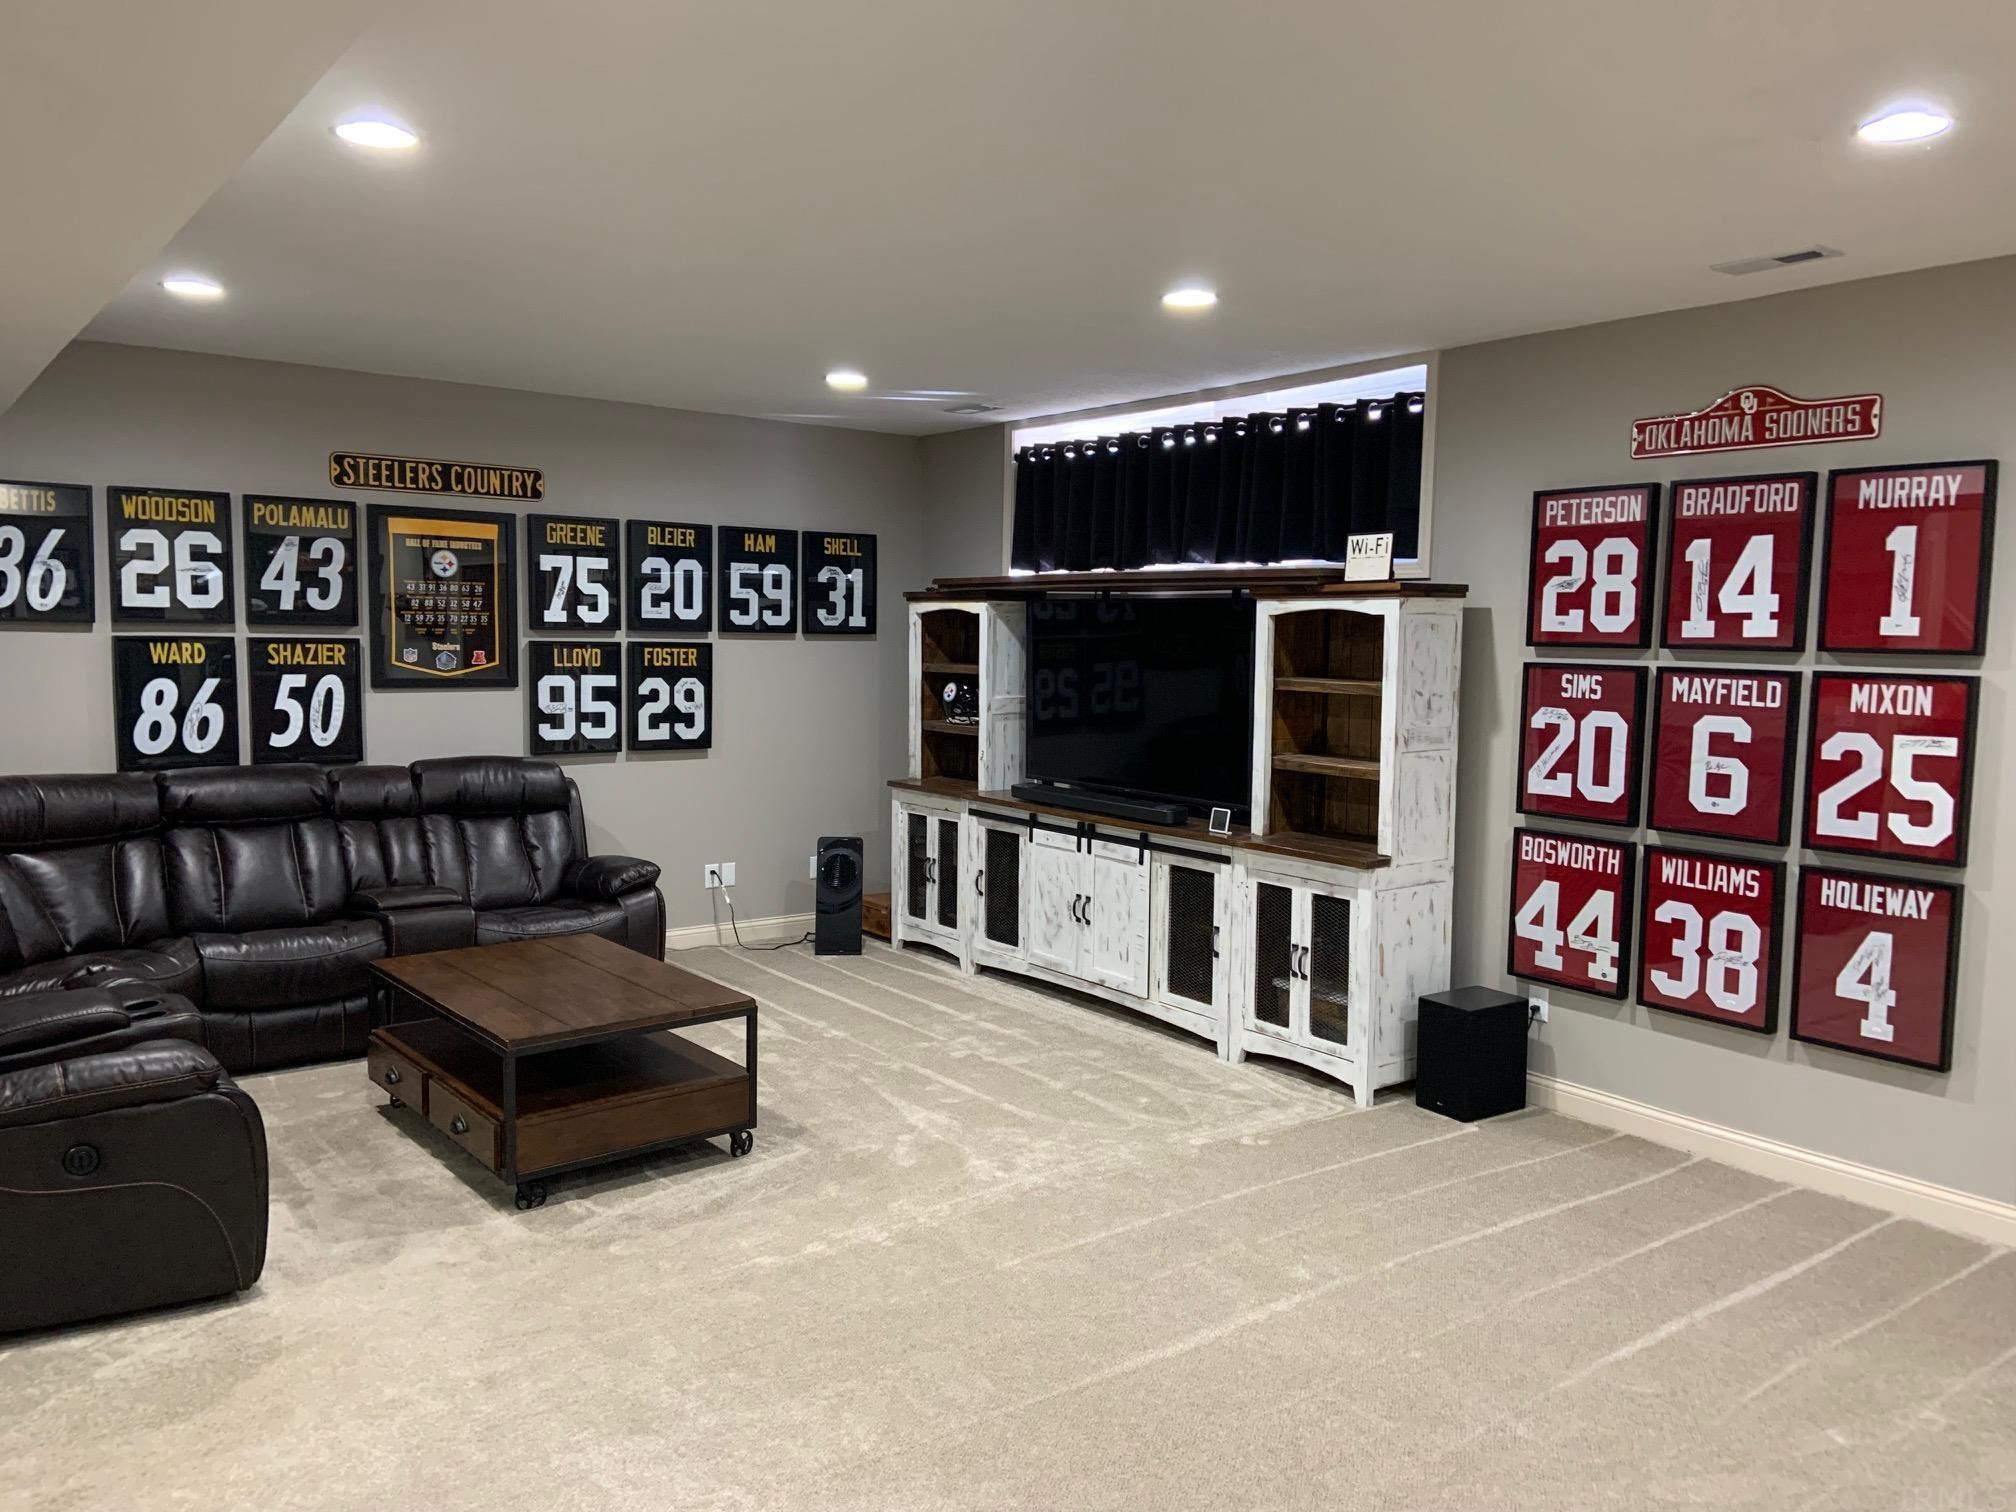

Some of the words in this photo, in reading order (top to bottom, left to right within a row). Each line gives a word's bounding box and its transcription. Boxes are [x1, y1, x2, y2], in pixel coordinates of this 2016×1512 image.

[1644, 414, 1754, 451] OKLAHOMA
[1765, 404, 1860, 439] SOONERS
[343, 458, 442, 489] STEELERS
[450, 465, 535, 498] COUNTRY
[1859, 474, 1963, 509] MURRAY
[122, 495, 215, 523] WOODSON
[254, 503, 348, 529] POLAMALU
[1546, 495, 1641, 526] PETERSON
[1682, 483, 1799, 516] BRADFORD
[547, 523, 605, 546] GREENE
[648, 527, 694, 547] BLEIER
[745, 534, 775, 553] HAM
[824, 538, 862, 556] SHELL
[1351, 537, 1389, 555] Wi-Fi
[120, 529, 223, 608] 26
[261, 536, 345, 610] 43
[540, 555, 609, 623] 75
[641, 557, 702, 620] 20
[1541, 537, 1638, 632] 28
[1682, 535, 1779, 638] 14
[1879, 526, 1920, 636] 1
[730, 563, 790, 625] 59
[817, 566, 866, 627] 31
[150, 643, 205, 663] WARD
[268, 644, 345, 665] SHAZIER
[554, 648, 600, 666] LLOYD
[645, 648, 697, 666] FOSTER
[1561, 674, 1602, 699] SIMS
[1672, 677, 1781, 707] MAYFIELD
[1850, 684, 1932, 716] MIXON
[134, 678, 224, 754] 86
[269, 674, 344, 747] 50
[538, 675, 616, 740] 95
[638, 678, 704, 741] 29
[1527, 707, 1628, 803] 20
[1689, 715, 1752, 815] 6
[1817, 732, 1958, 847] 25
[1522, 836, 1620, 874] BOSWORTH
[1662, 857, 1760, 897] WILLIAMS
[1821, 878, 1934, 919] HOLIEWAY
[1515, 880, 1619, 983] 44
[1651, 900, 1761, 1013] 38
[1836, 931, 1896, 1042] 4
